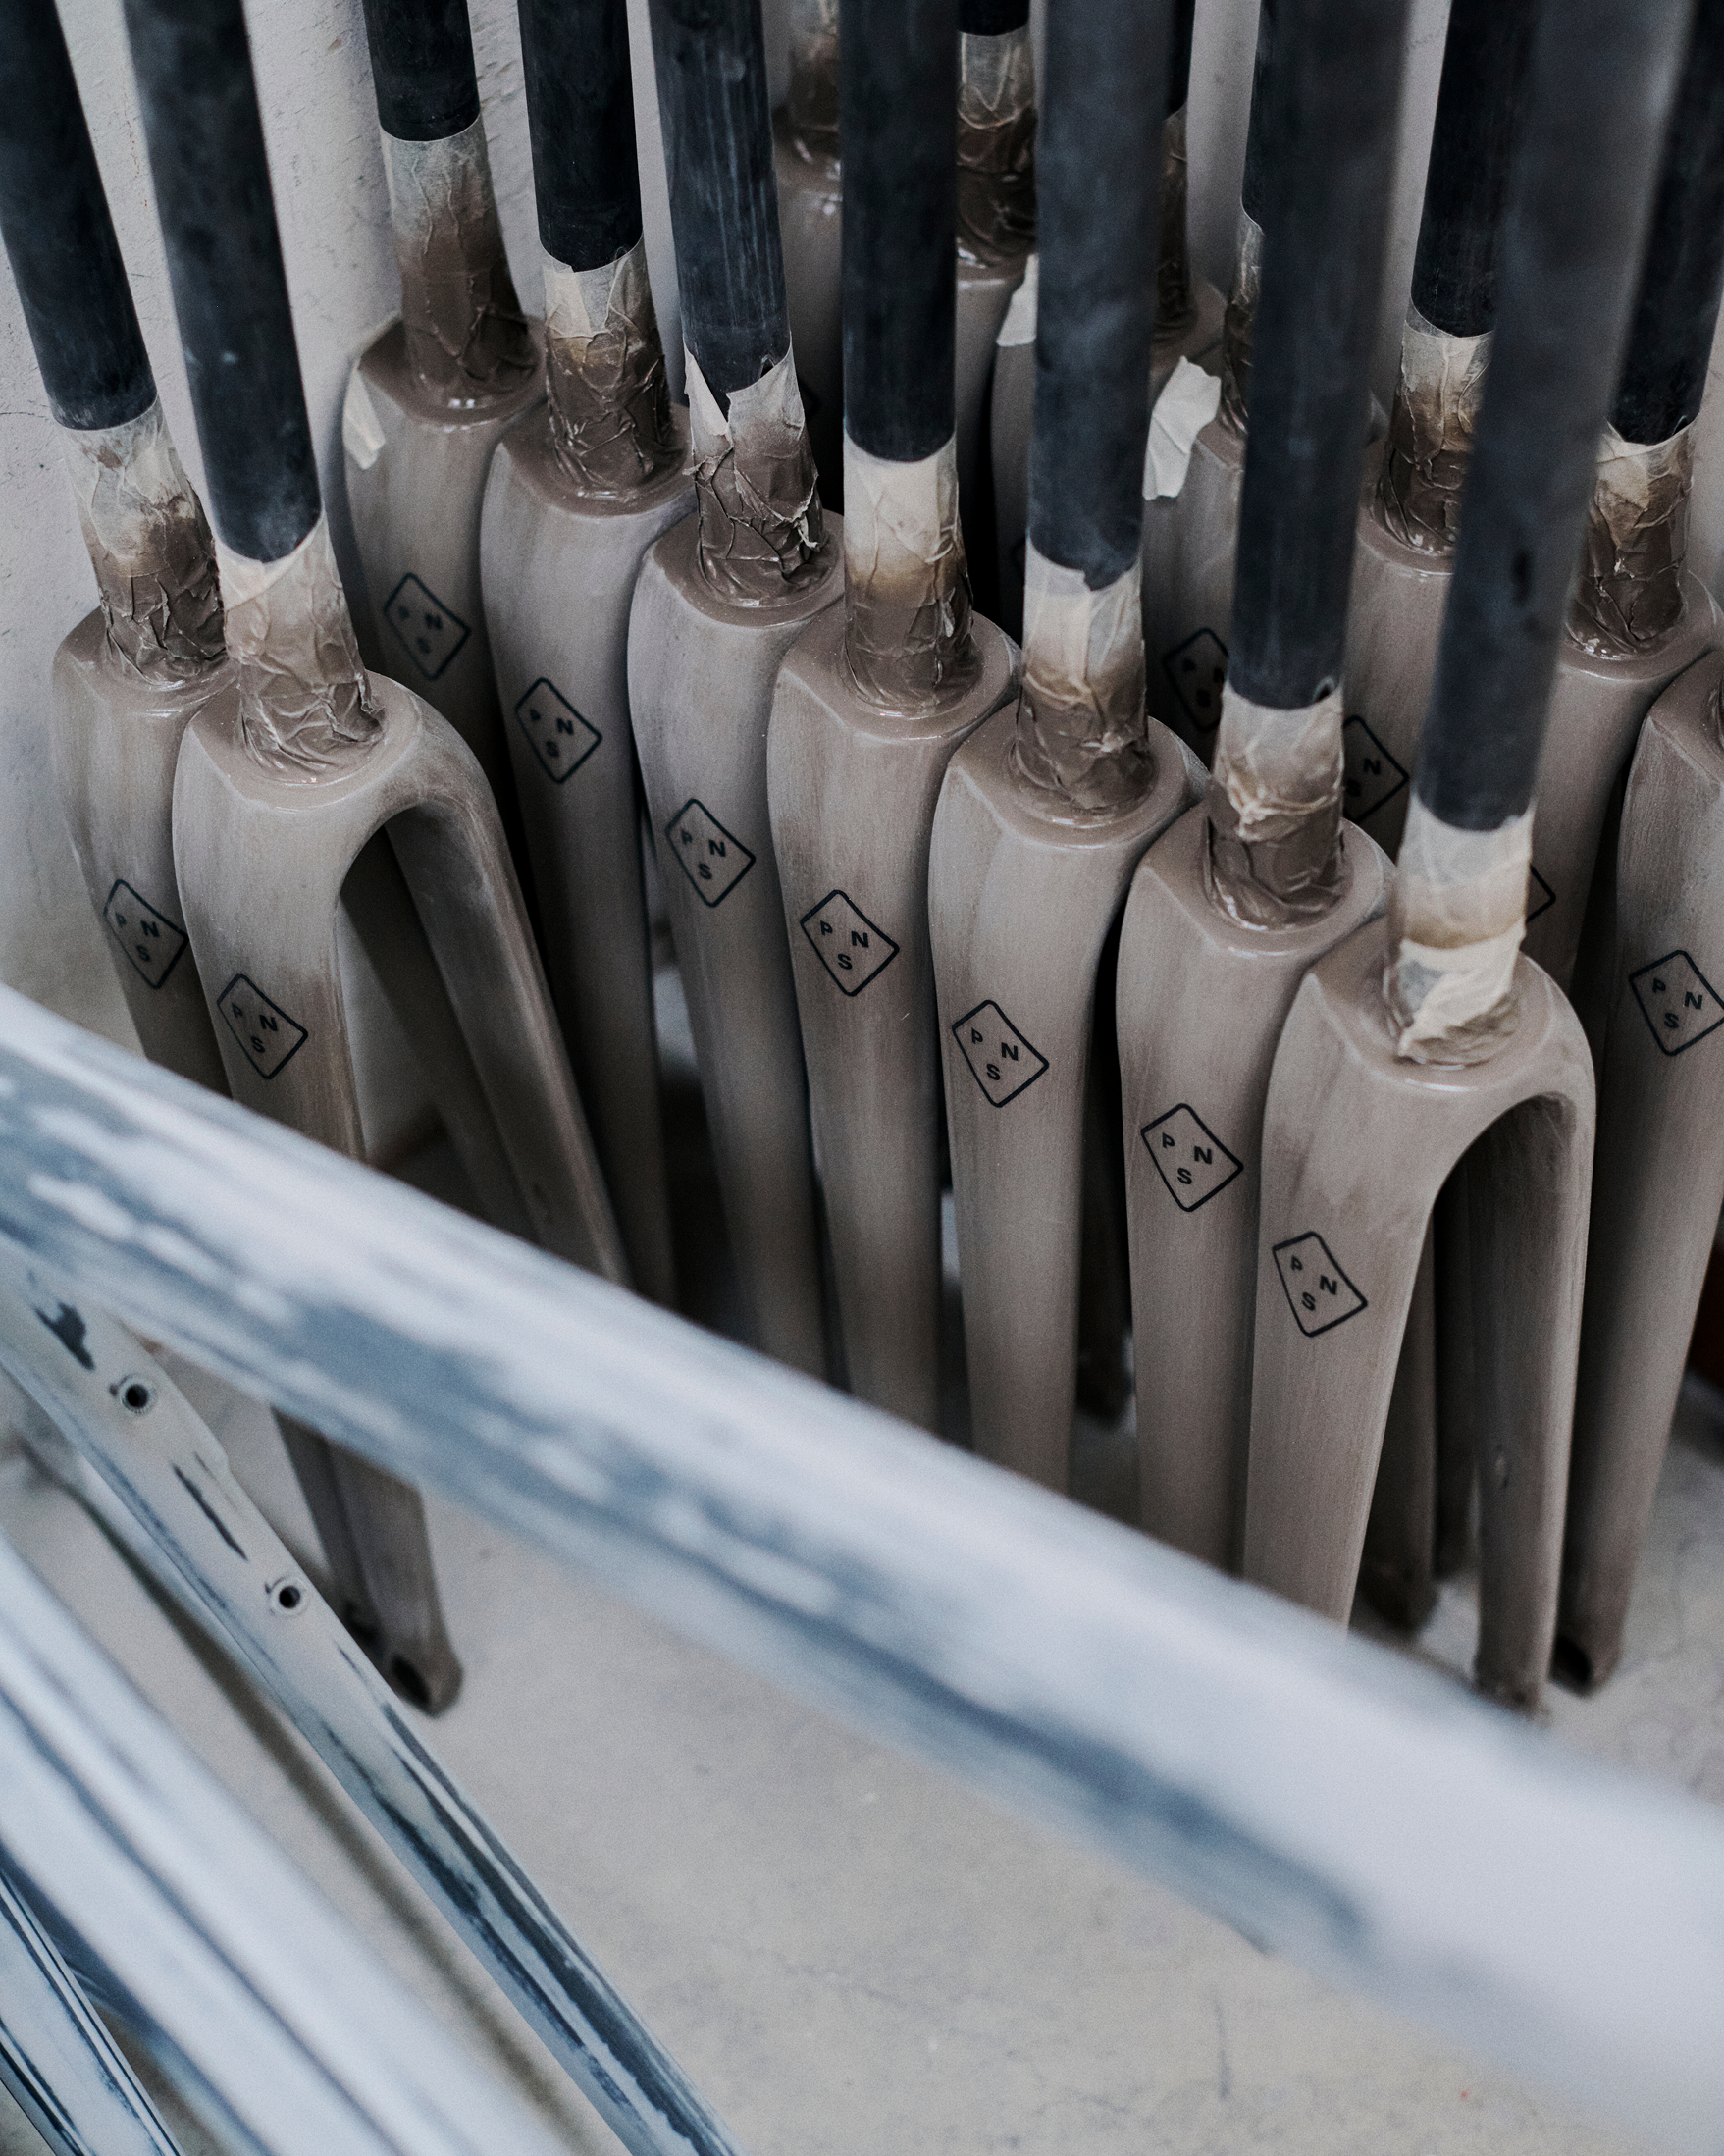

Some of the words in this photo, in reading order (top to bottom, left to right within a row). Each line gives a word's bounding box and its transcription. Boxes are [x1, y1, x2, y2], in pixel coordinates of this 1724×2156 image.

[708, 840, 726, 857] N
[698, 863, 712, 880] S
[141, 921, 160, 938] N
[820, 920, 833, 935] P
[852, 931, 868, 948] N
[136, 945, 152, 963] S
[838, 954, 852, 970] S
[1652, 978, 1666, 993] P
[1685, 991, 1702, 1009] N
[259, 1015, 278, 1031] N
[1664, 1013, 1679, 1029] S
[250, 1036, 265, 1053] S
[971, 1028, 983, 1044] P
[1001, 1042, 1018, 1061] N
[987, 1064, 1000, 1080] S
[1163, 1132, 1175, 1148] P
[1194, 1146, 1212, 1164] N
[1177, 1168, 1192, 1184] S
[1291, 1256, 1302, 1271] P
[1320, 1276, 1337, 1294] N
[1302, 1292, 1315, 1311] S
